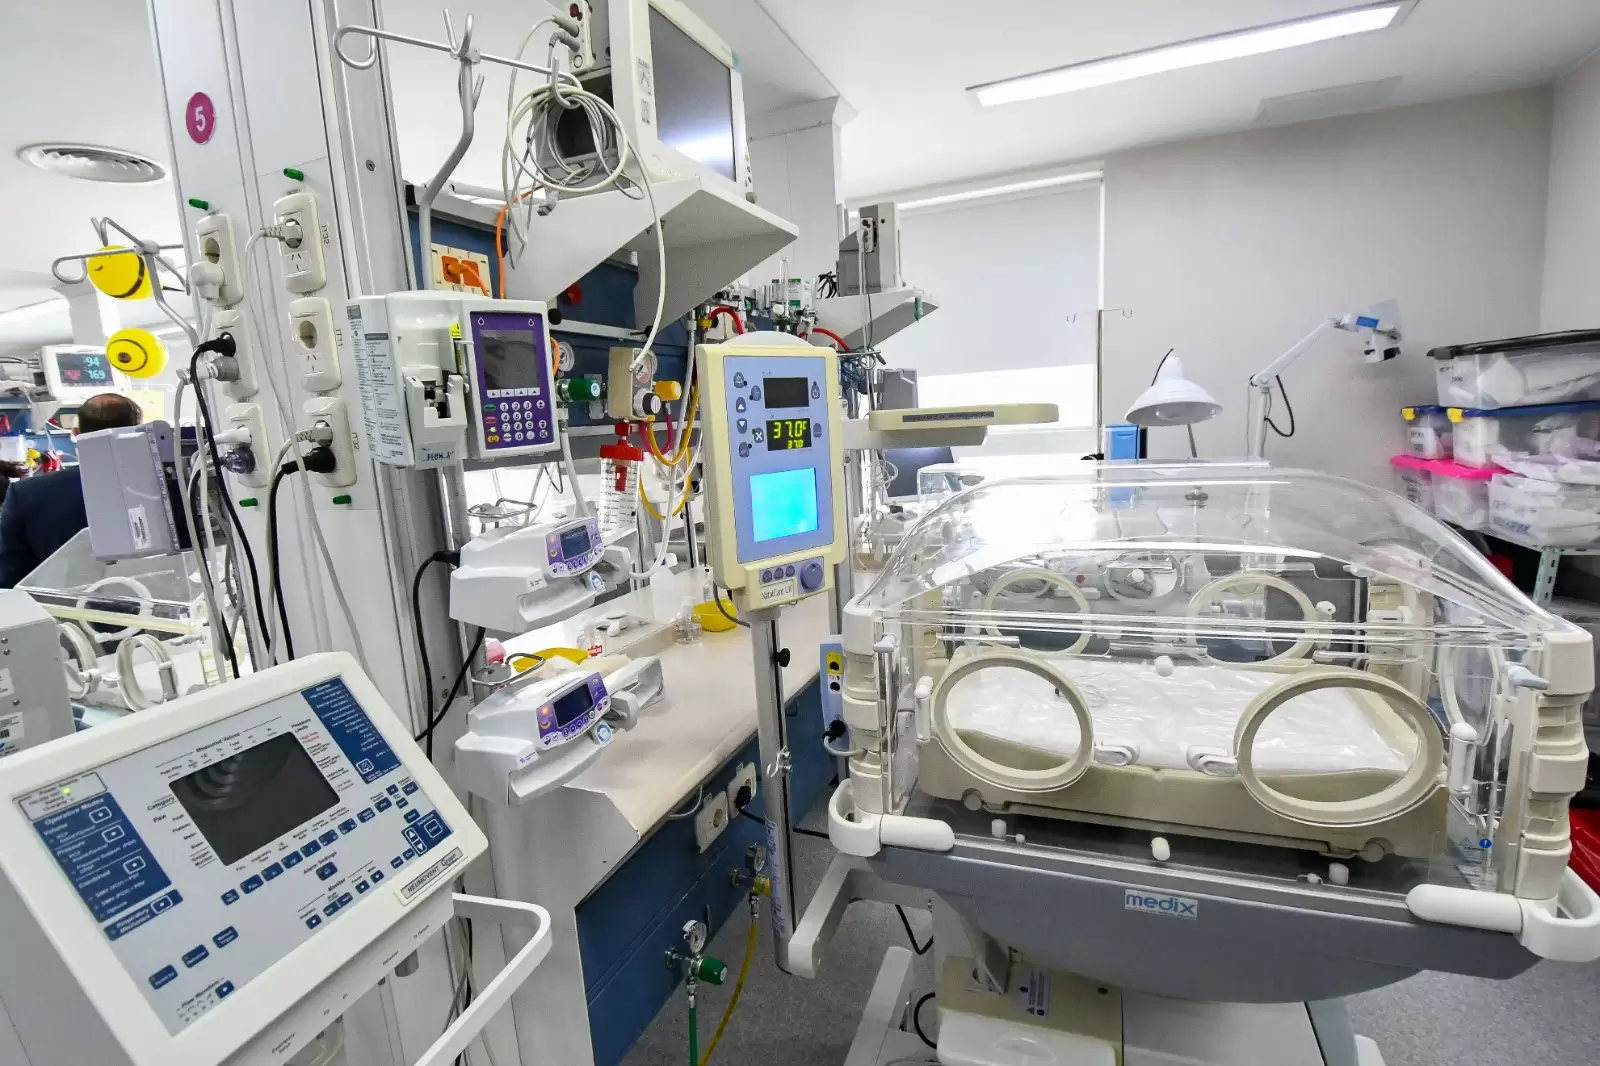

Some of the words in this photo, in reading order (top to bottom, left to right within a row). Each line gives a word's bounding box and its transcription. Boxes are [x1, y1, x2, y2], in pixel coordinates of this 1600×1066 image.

[194, 105, 206, 132] 5
[85, 355, 100, 367] 94
[88, 369, 106, 380] 169
[45, 808, 81, 826] Operative
[81, 798, 105, 811] Modes
[147, 796, 175, 812] Category
[153, 814, 167, 823] Paw
[303, 863, 318, 875] Alarm
[318, 851, 337, 865] Settings
[328, 878, 346, 892] Monitor
[407, 865, 441, 893] NEUMOVENT
[1126, 893, 1195, 915] medix
